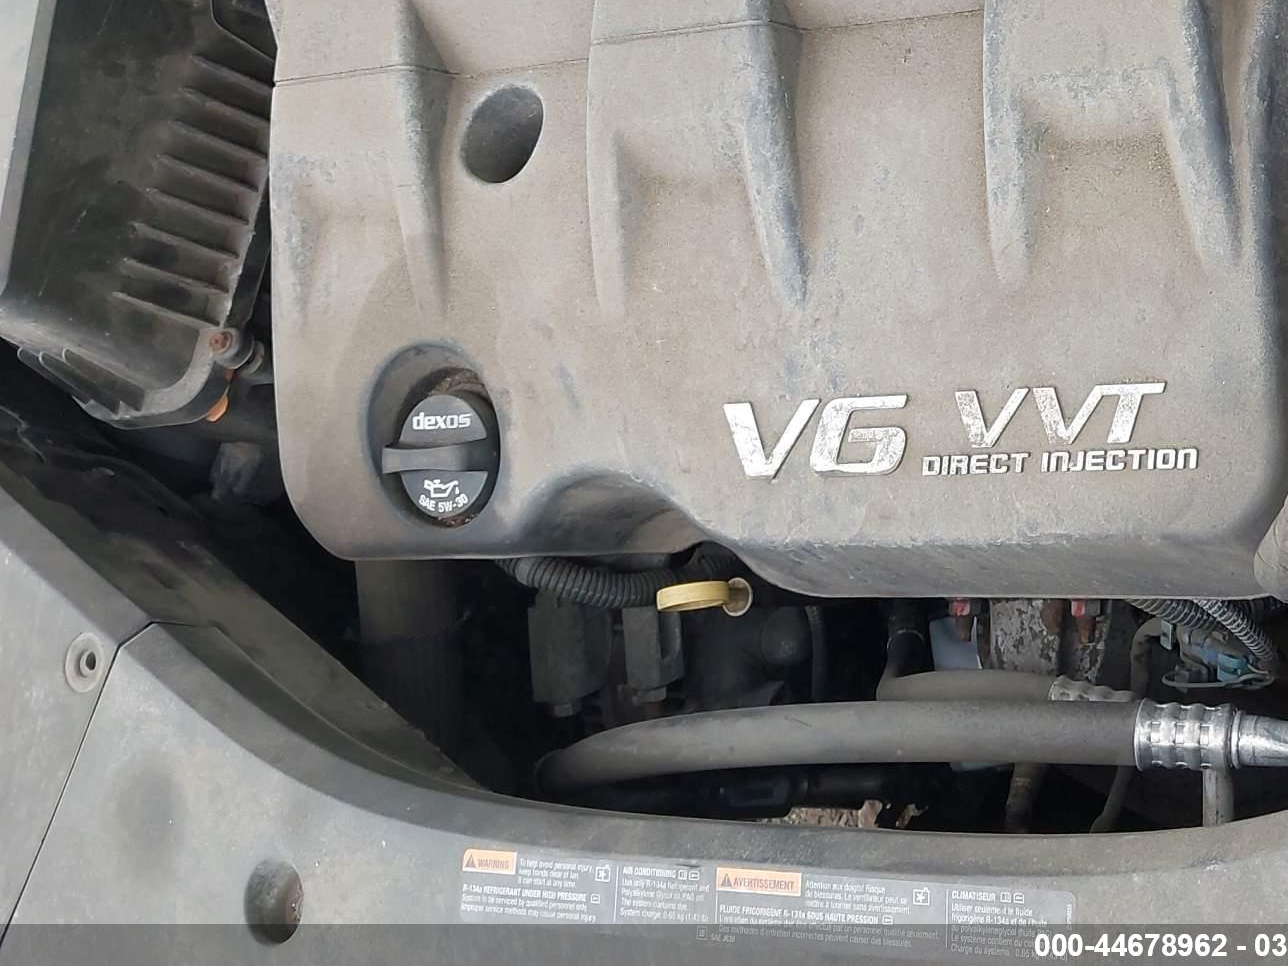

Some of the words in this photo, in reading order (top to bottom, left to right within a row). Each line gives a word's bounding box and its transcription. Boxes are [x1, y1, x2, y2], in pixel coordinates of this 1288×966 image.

[412, 412, 472, 430] dexos
[724, 393, 908, 478] V6
[956, 382, 1167, 448] VVT
[922, 452, 1032, 476] DIRECT
[1040, 448, 1198, 474] INJECTION
[419, 494, 436, 512] SAE
[438, 493, 468, 512] 5W-30
[477, 857, 509, 869] WARNING
[538, 859, 552, 868] avoid
[554, 861, 576, 871] personal
[532, 868, 549, 877] hands
[622, 865, 633, 874] AIR
[634, 866, 676, 878] CONDITIONING
[733, 876, 794, 890] AVERTISSEMENT
[805, 879, 831, 890] Attention
[865, 884, 885, 895] Risque
[462, 882, 482, 892] R-134a
[483, 884, 520, 896] REFRIGERANT
[521, 888, 541, 898] UNDER
[542, 890, 556, 899] HIGH
[557, 891, 587, 902] PRESSURE
[853, 893, 883, 904] ventilateur
[951, 889, 995, 901] CLIMATISEUR
[719, 903, 740, 913] FLUIDE
[806, 910, 824, 920] SOUS
[824, 911, 845, 922] HAUTE
[846, 913, 878, 925] PRESSION
[951, 901, 972, 912] Utiliser
[1015, 906, 1032, 917] fluide
